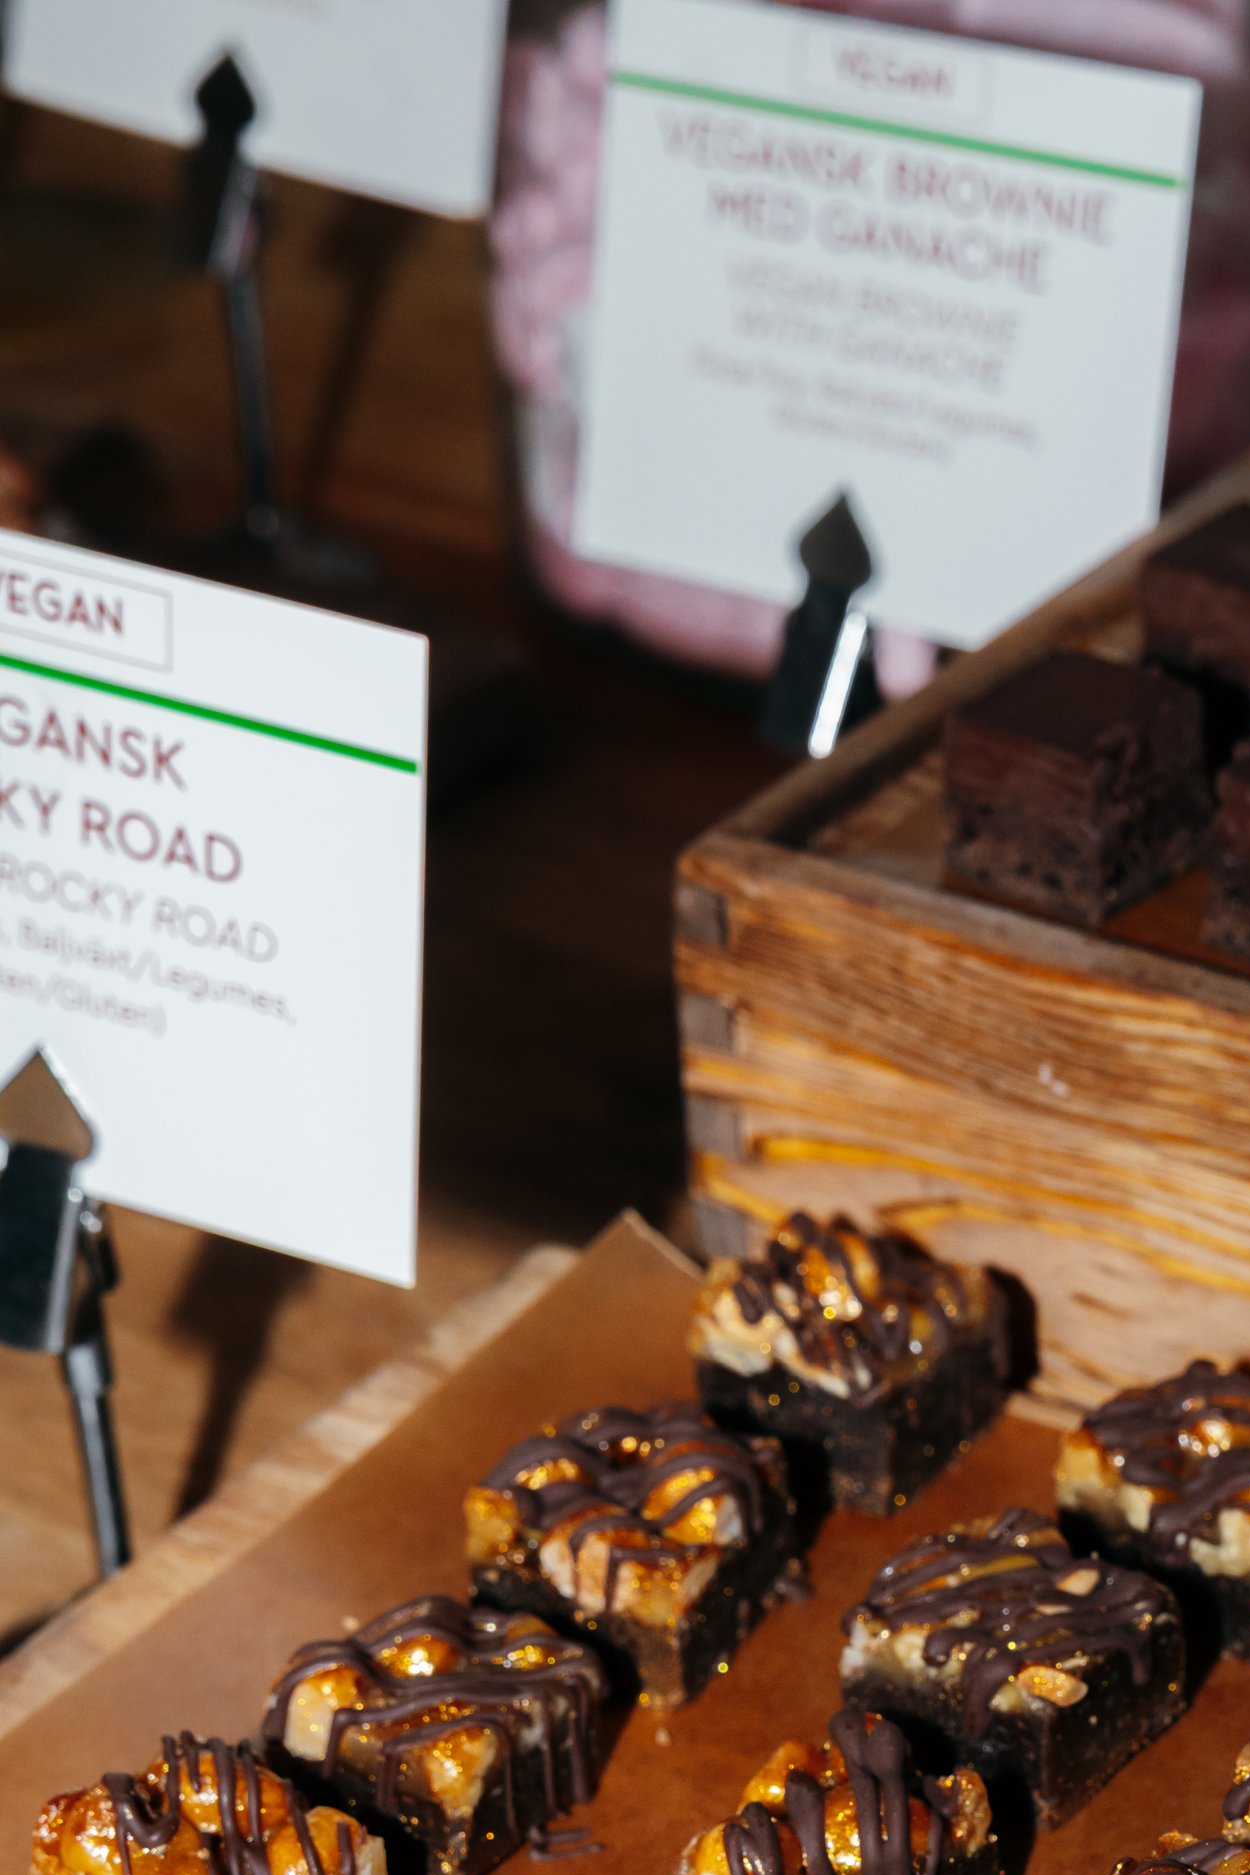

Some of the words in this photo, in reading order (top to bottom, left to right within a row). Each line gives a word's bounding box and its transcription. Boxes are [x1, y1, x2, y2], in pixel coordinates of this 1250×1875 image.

[888, 153, 1113, 244] BROWNIE
[80, 796, 245, 884] ROAD
[152, 895, 280, 965] ROAD
